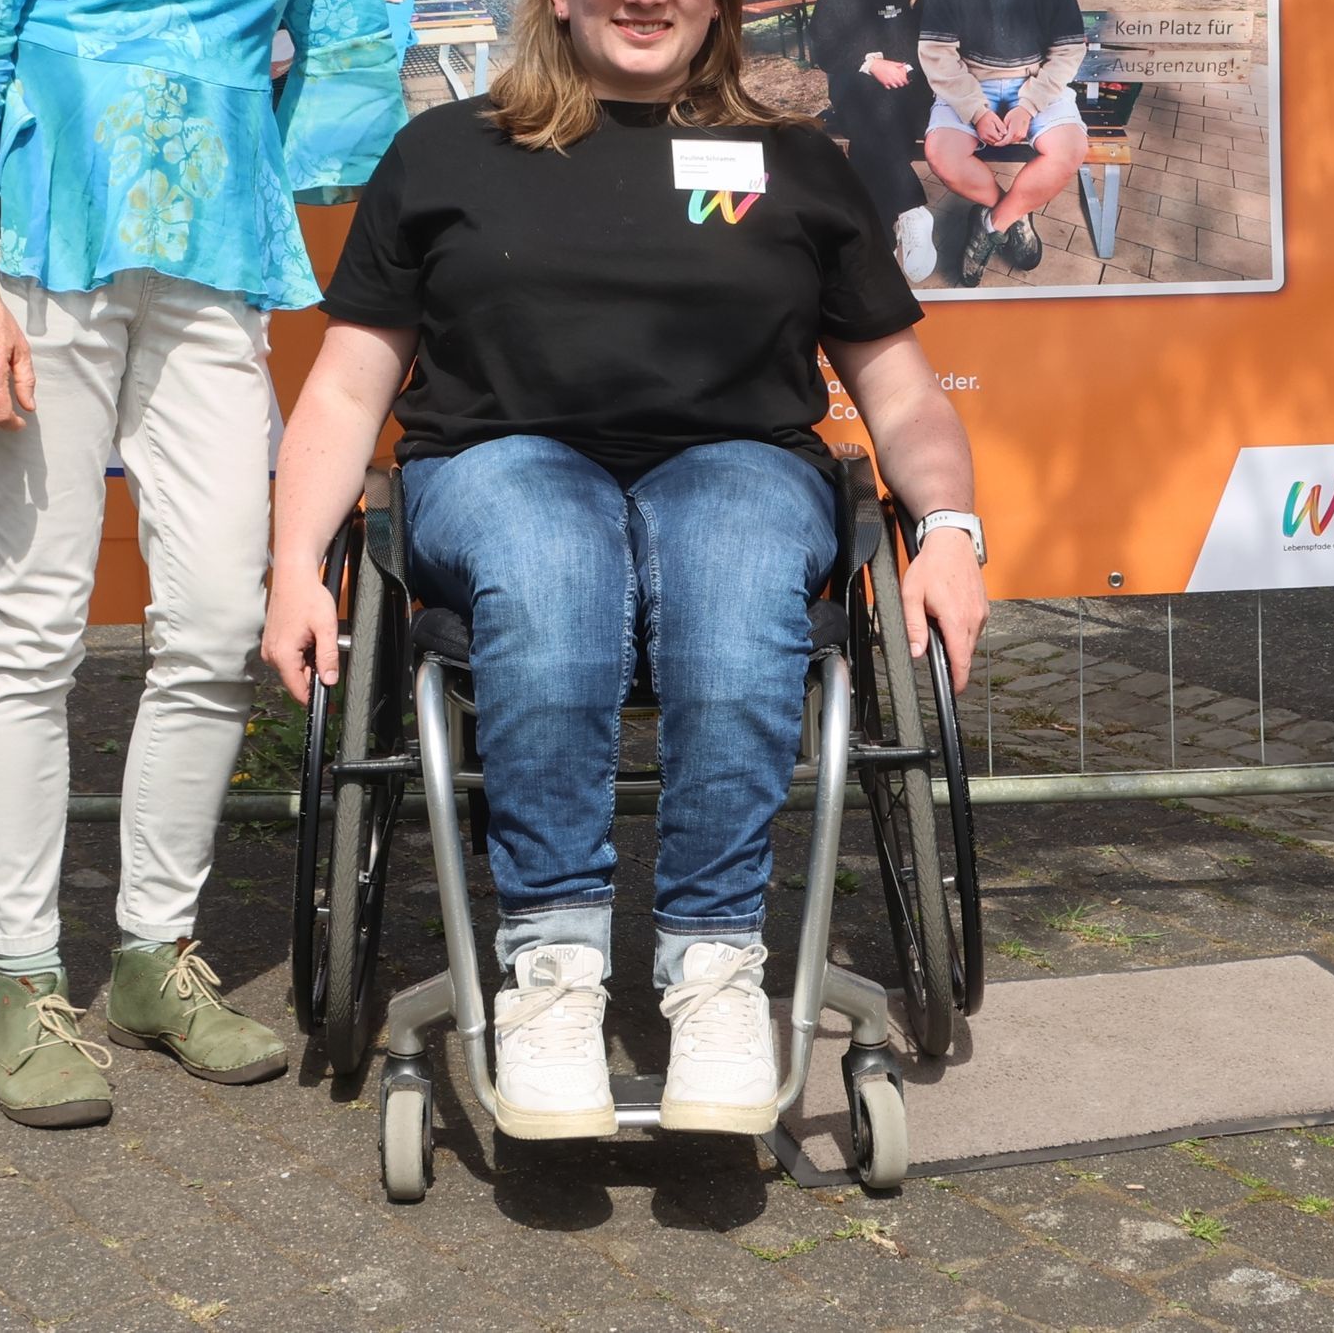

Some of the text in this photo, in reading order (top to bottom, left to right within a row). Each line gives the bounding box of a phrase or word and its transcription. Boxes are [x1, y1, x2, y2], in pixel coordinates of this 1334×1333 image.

[1115, 18, 1234, 36] Kein Platz für
[1112, 57, 1234, 76] Ausgrenzung!
[1283, 543, 1331, 552] Lebenspfade
